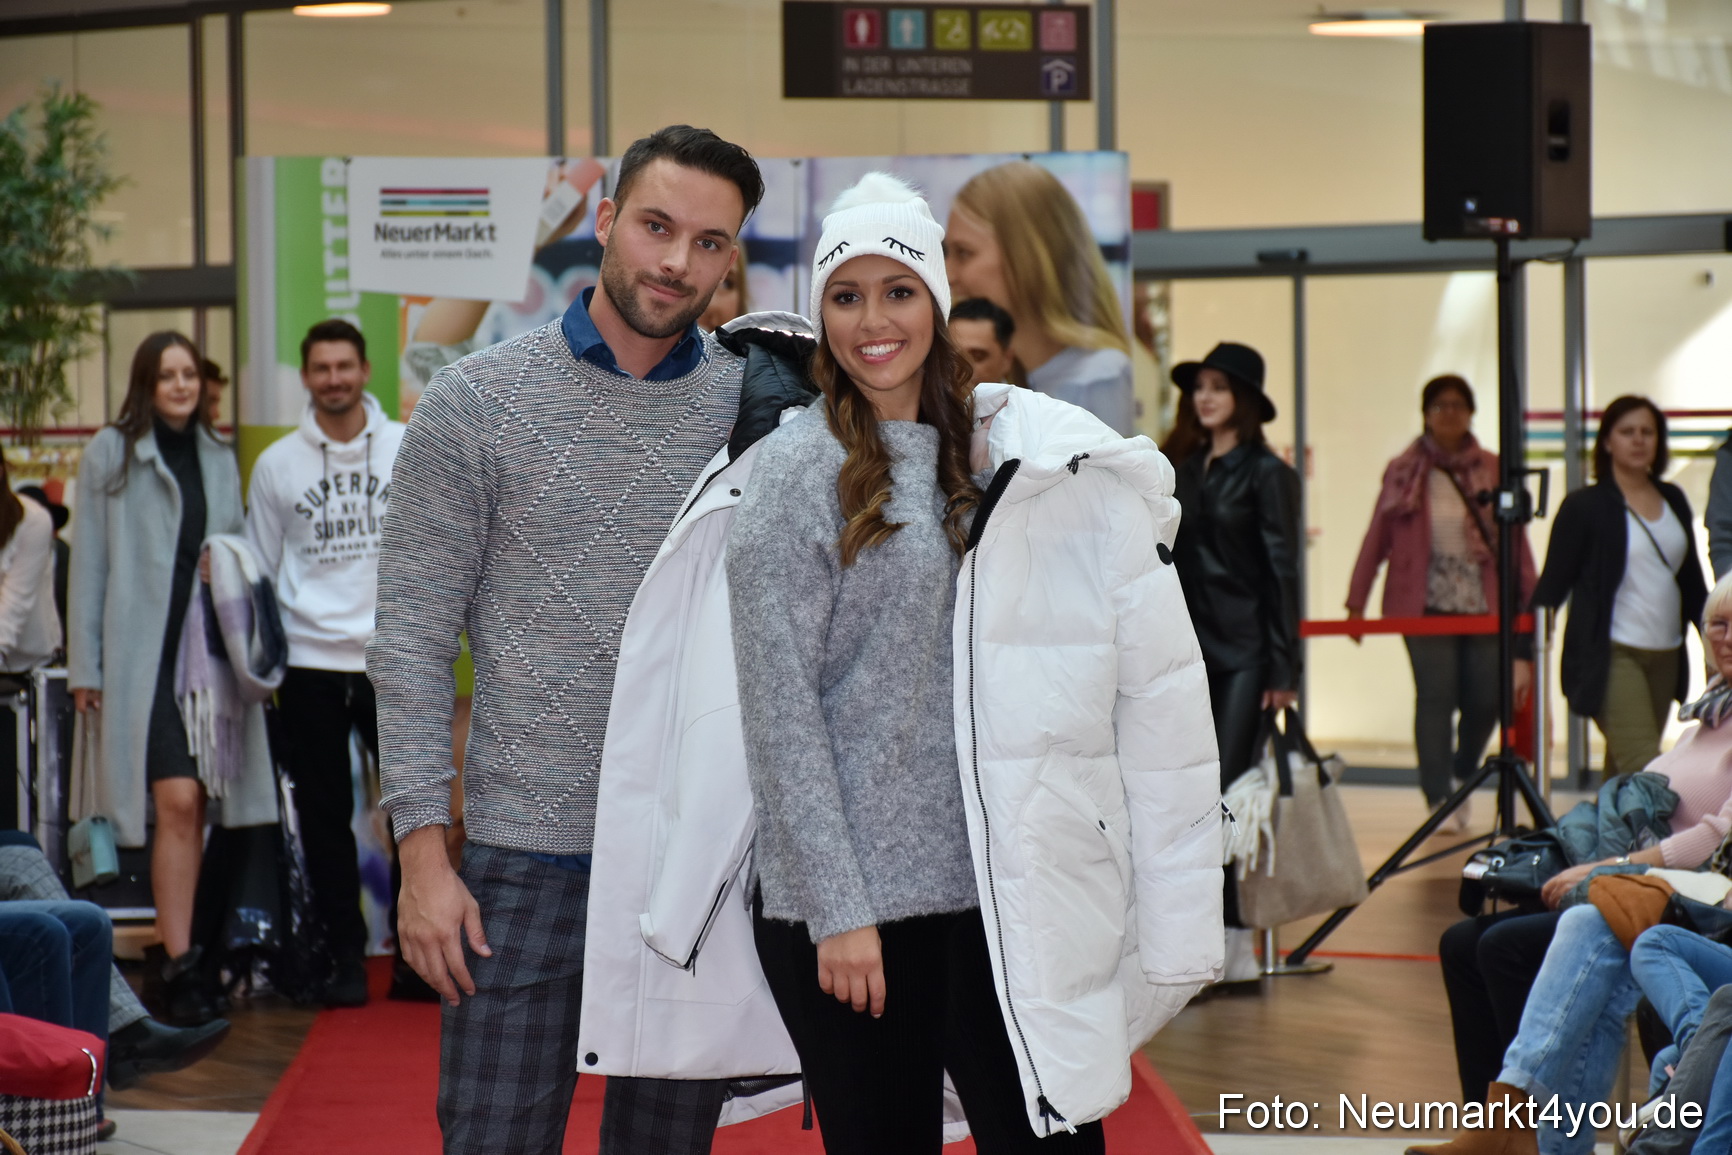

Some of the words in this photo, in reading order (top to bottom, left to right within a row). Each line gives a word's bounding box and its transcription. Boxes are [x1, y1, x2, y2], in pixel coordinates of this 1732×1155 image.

[844, 57, 860, 73] IN
[862, 57, 891, 73] DER
[896, 57, 973, 74] UNTEREN
[843, 78, 969, 95] LADENSTRASSE
[374, 223, 497, 241] NeuerMarkt
[321, 157, 362, 333] UTTER
